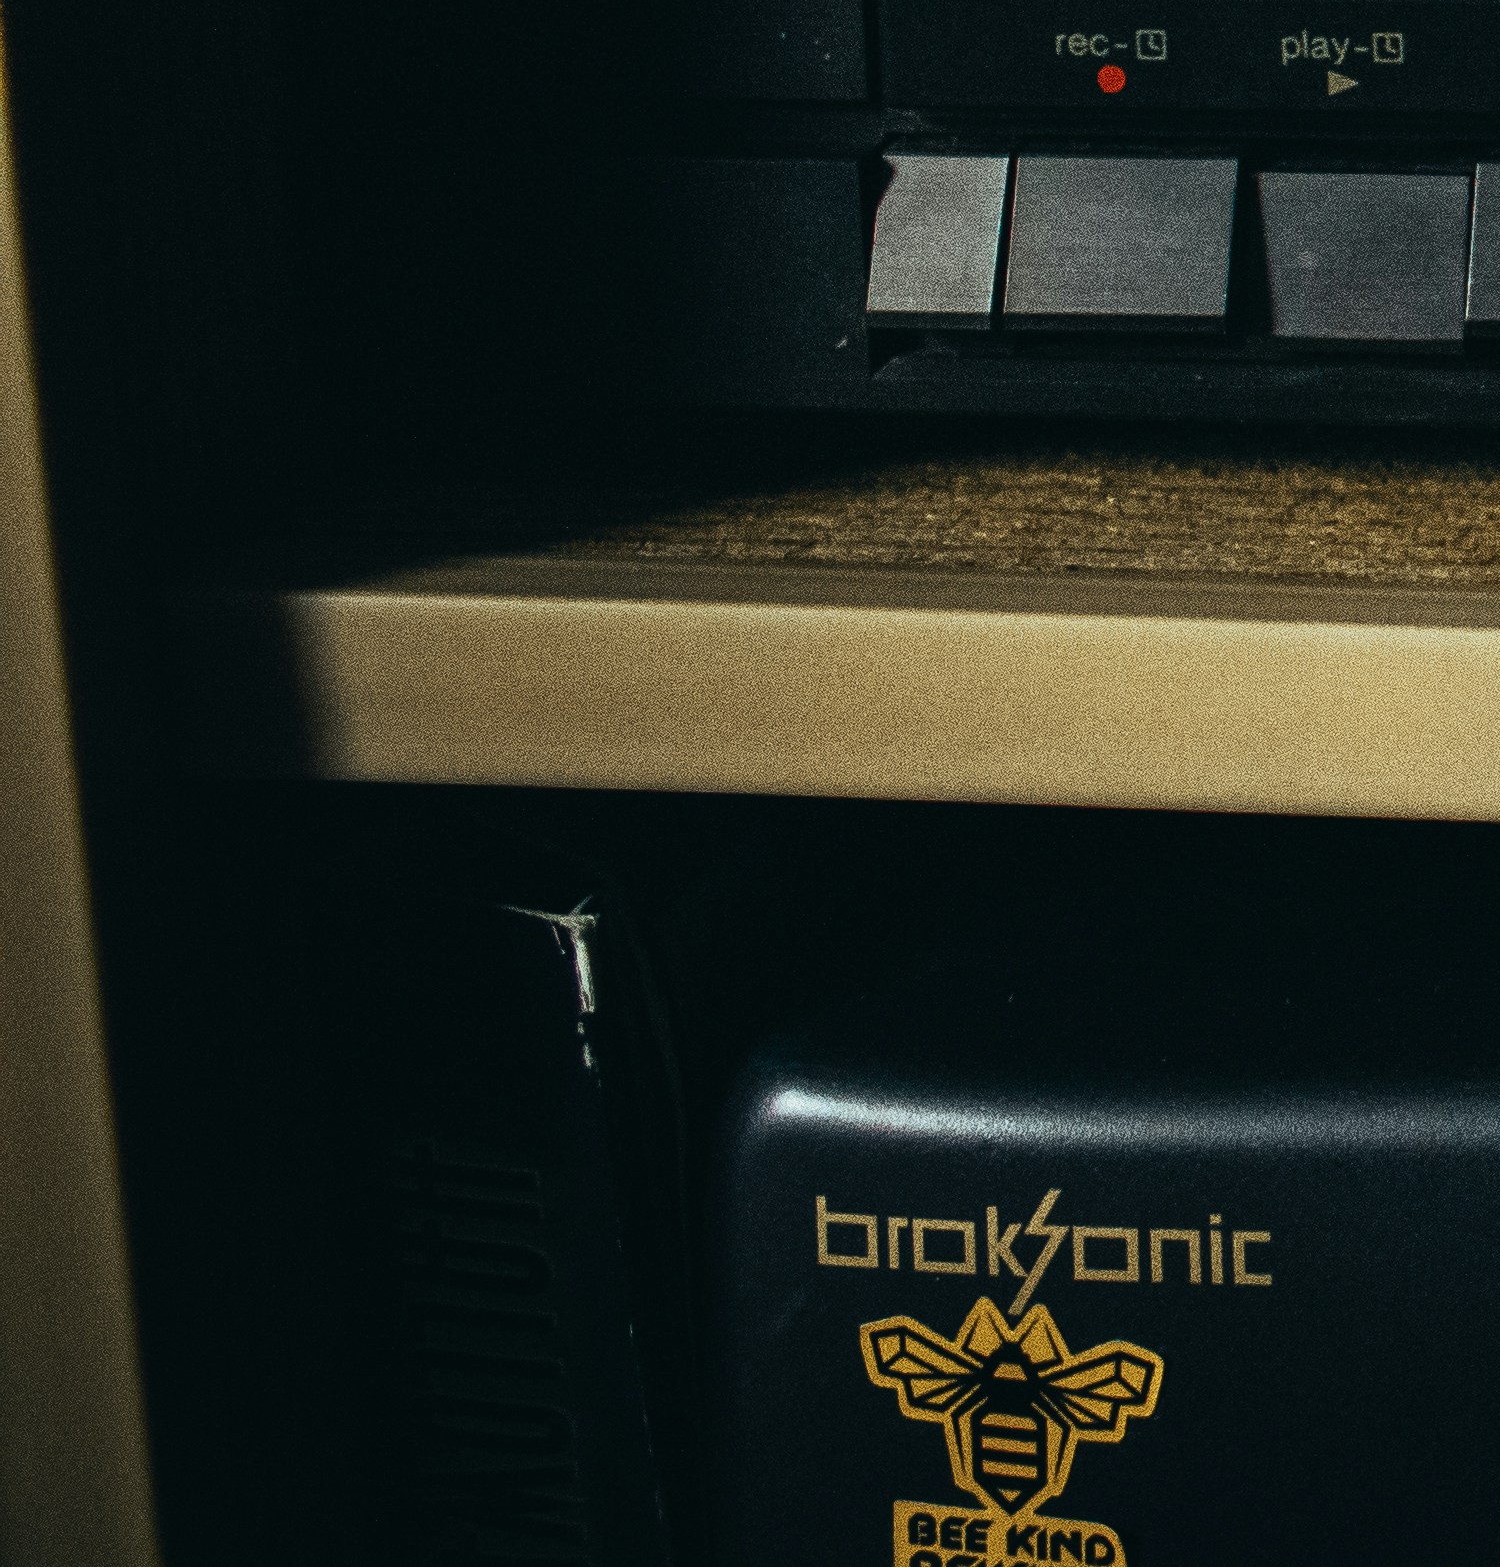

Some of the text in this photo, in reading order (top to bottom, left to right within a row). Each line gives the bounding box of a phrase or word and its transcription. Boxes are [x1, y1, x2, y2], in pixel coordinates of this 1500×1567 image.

[816, 1189, 1271, 1317] broksonic
[907, 1512, 993, 1554] BEE
[1006, 1525, 1116, 1567] KIND
